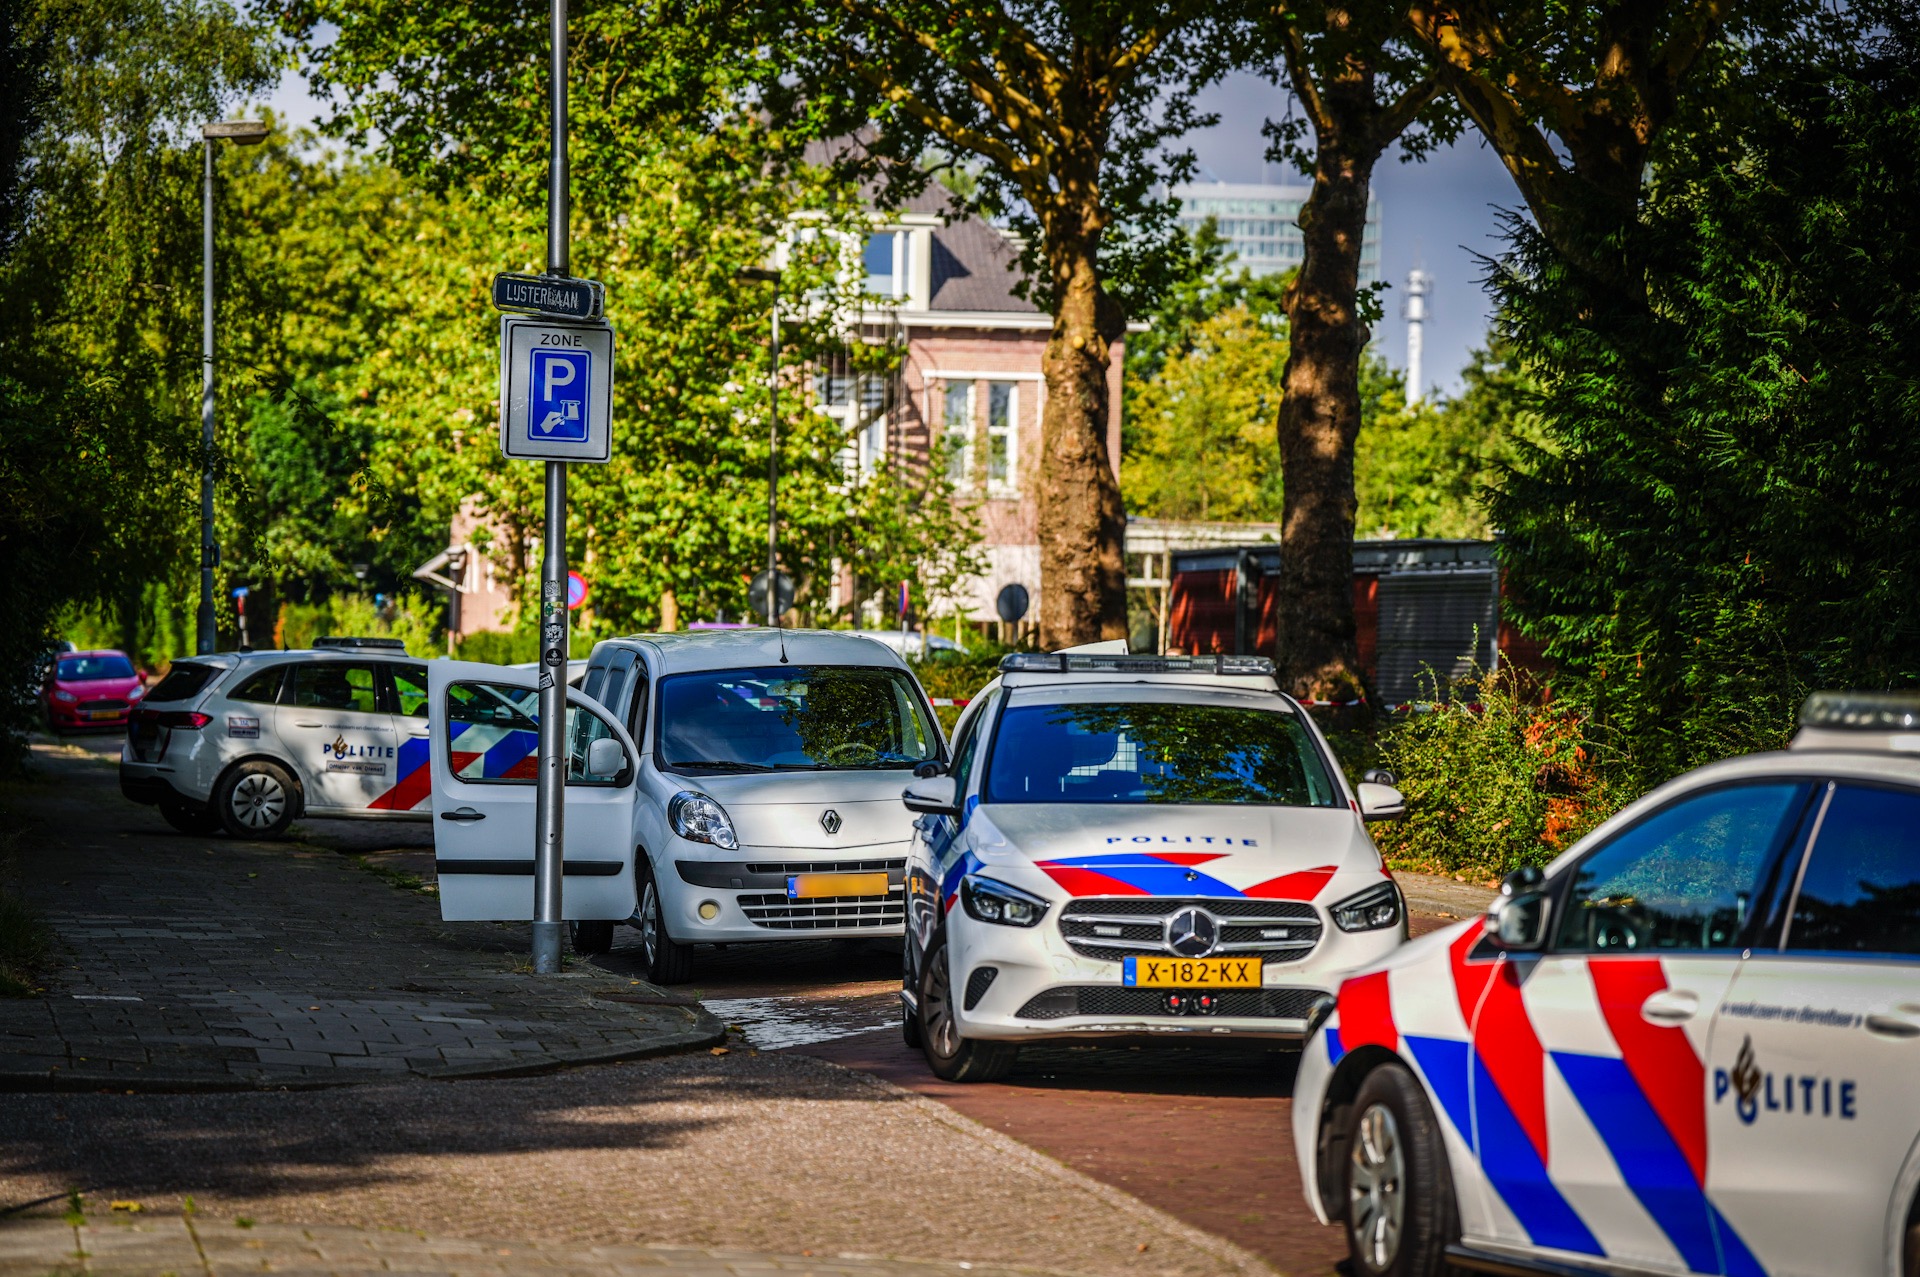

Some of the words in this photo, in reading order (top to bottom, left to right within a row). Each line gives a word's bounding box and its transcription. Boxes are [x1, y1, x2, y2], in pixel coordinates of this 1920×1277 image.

[540, 333, 583, 347] ZONE
[543, 357, 576, 402] P
[323, 743, 394, 760] POLITIE
[1106, 836, 1259, 847] POLITIE
[1147, 962, 1249, 983] X-182-KX
[1714, 1067, 1857, 1126] POLITIE
